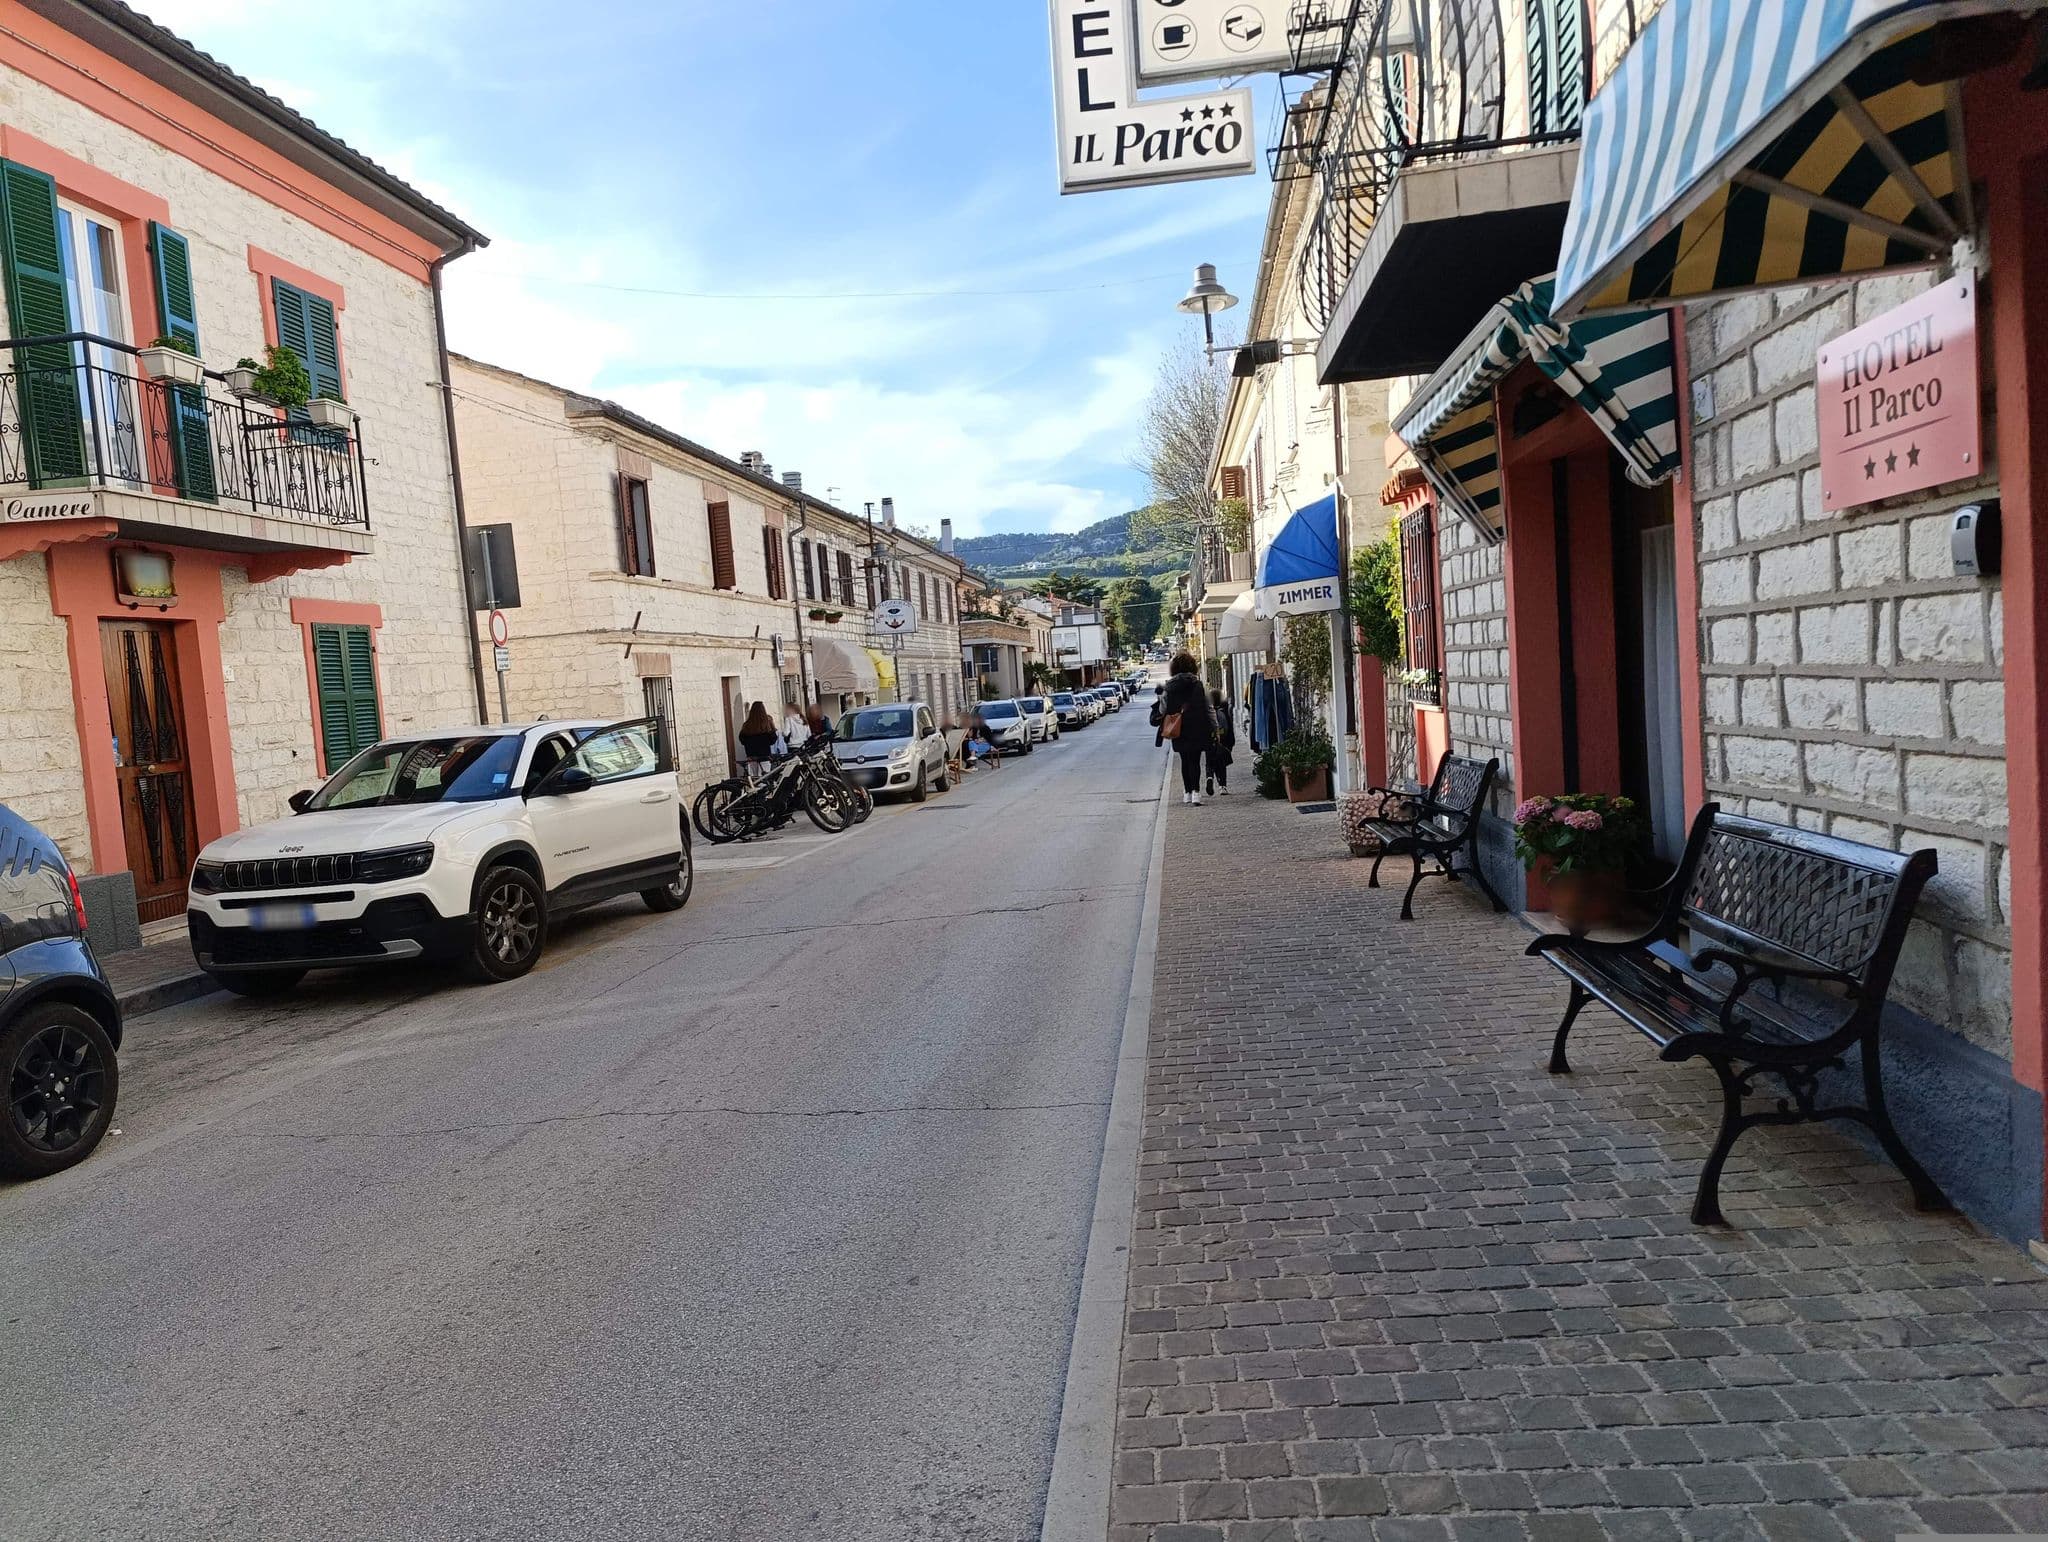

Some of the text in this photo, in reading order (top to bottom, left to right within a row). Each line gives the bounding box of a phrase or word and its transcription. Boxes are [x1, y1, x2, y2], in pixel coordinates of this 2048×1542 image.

[1072, 0, 1116, 112] EL
[1073, 121, 1243, 166] IL Parco
[1842, 314, 1943, 392] HOTEL
[1843, 378, 1942, 438] Il Parco
[7, 499, 91, 520] Camere
[1279, 585, 1332, 604] ZIMMER
